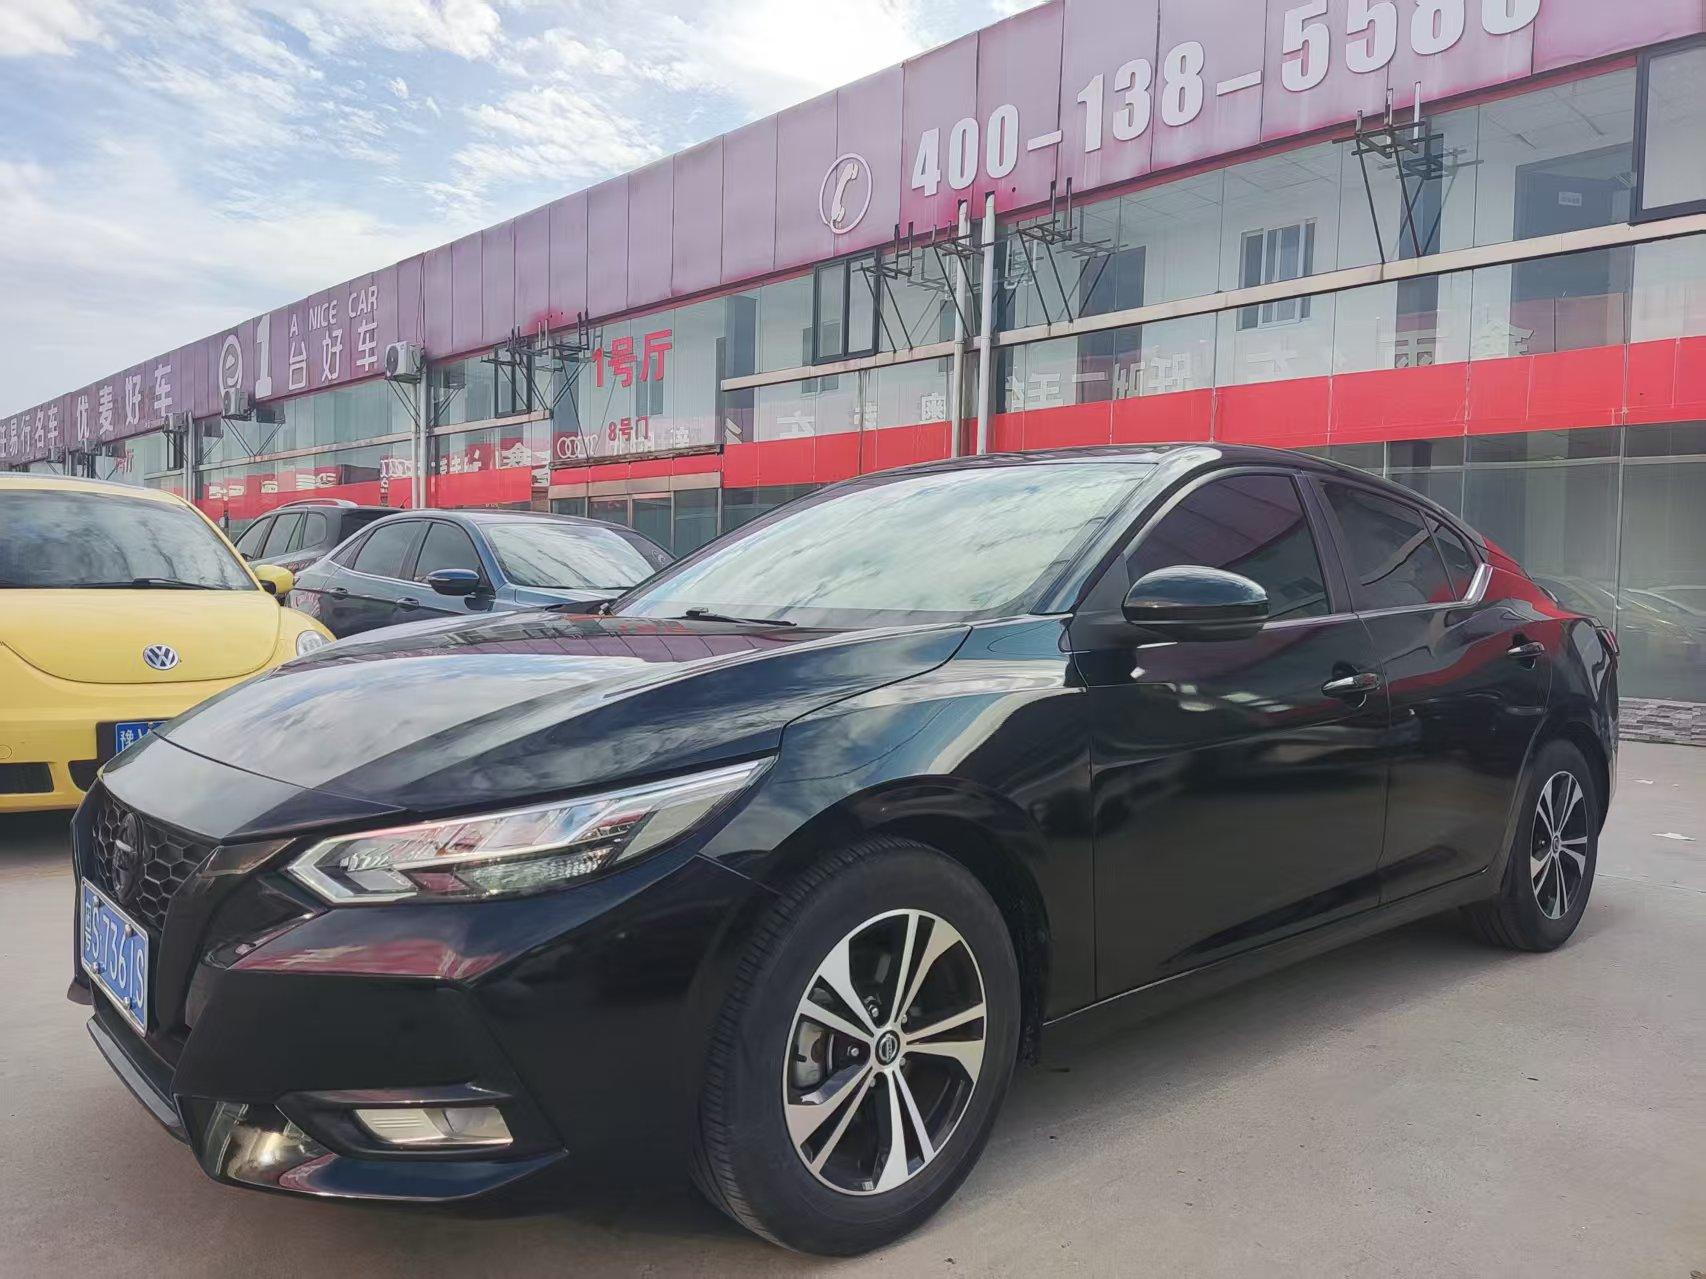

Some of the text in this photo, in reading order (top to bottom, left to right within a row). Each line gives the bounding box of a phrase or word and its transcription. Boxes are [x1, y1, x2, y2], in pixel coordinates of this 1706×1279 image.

[290, 285, 378, 338] A NICE CAR
[591, 328, 673, 388] 1号厅
[76, 363, 173, 444] 优麦好车
[608, 415, 649, 442] 8号门
